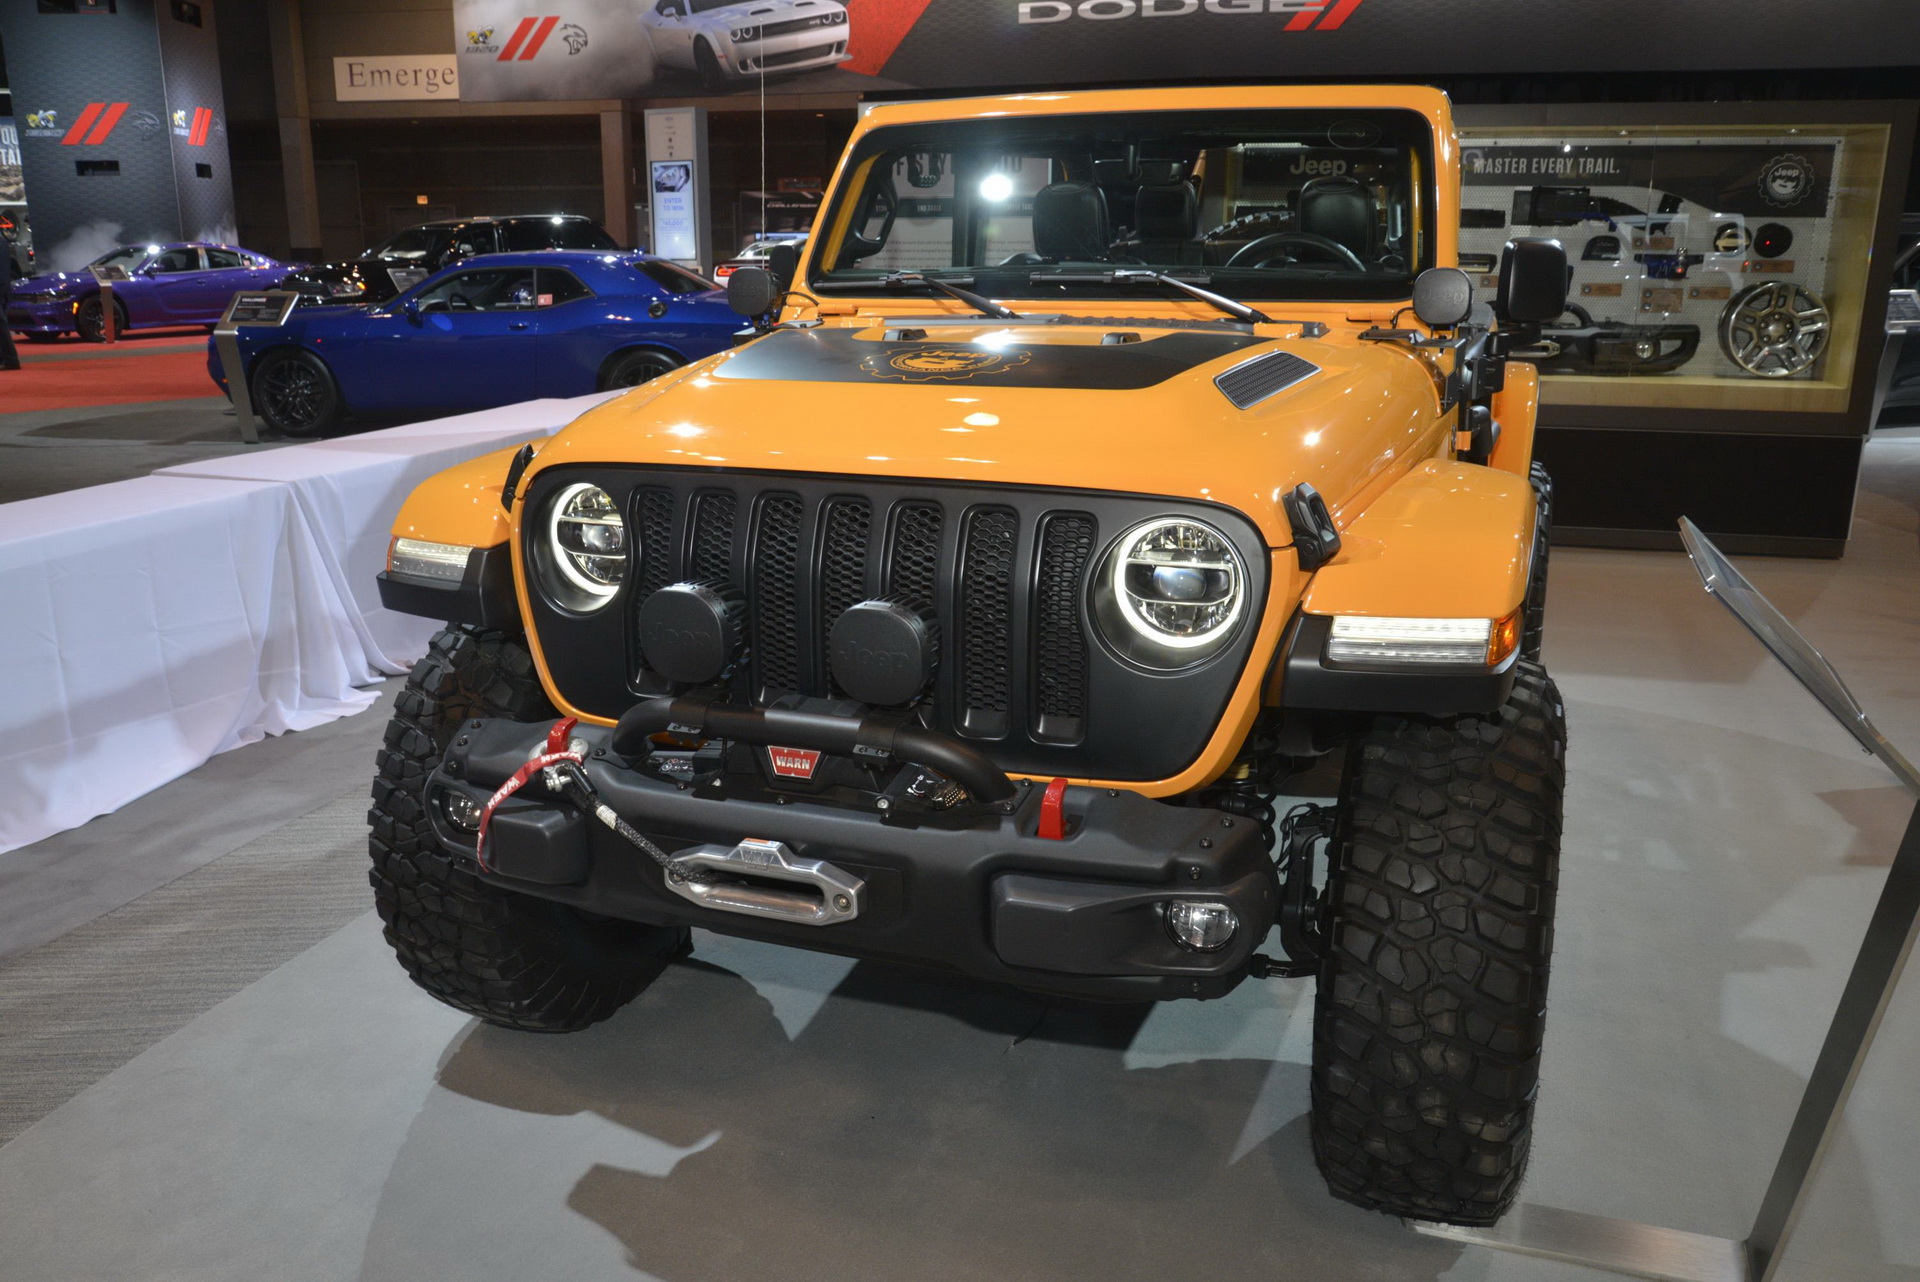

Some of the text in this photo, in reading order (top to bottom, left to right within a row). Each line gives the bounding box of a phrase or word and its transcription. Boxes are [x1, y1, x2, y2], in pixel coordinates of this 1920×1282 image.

[346, 62, 455, 93] Emerge
[1289, 155, 1347, 177] Jeep
[1473, 157, 1620, 174] MASTER EVERY TRAIL.
[1774, 167, 1799, 178] Jeep
[920, 350, 989, 358] Jeep
[776, 756, 811, 770] WARN
[487, 776, 520, 811] WARN
